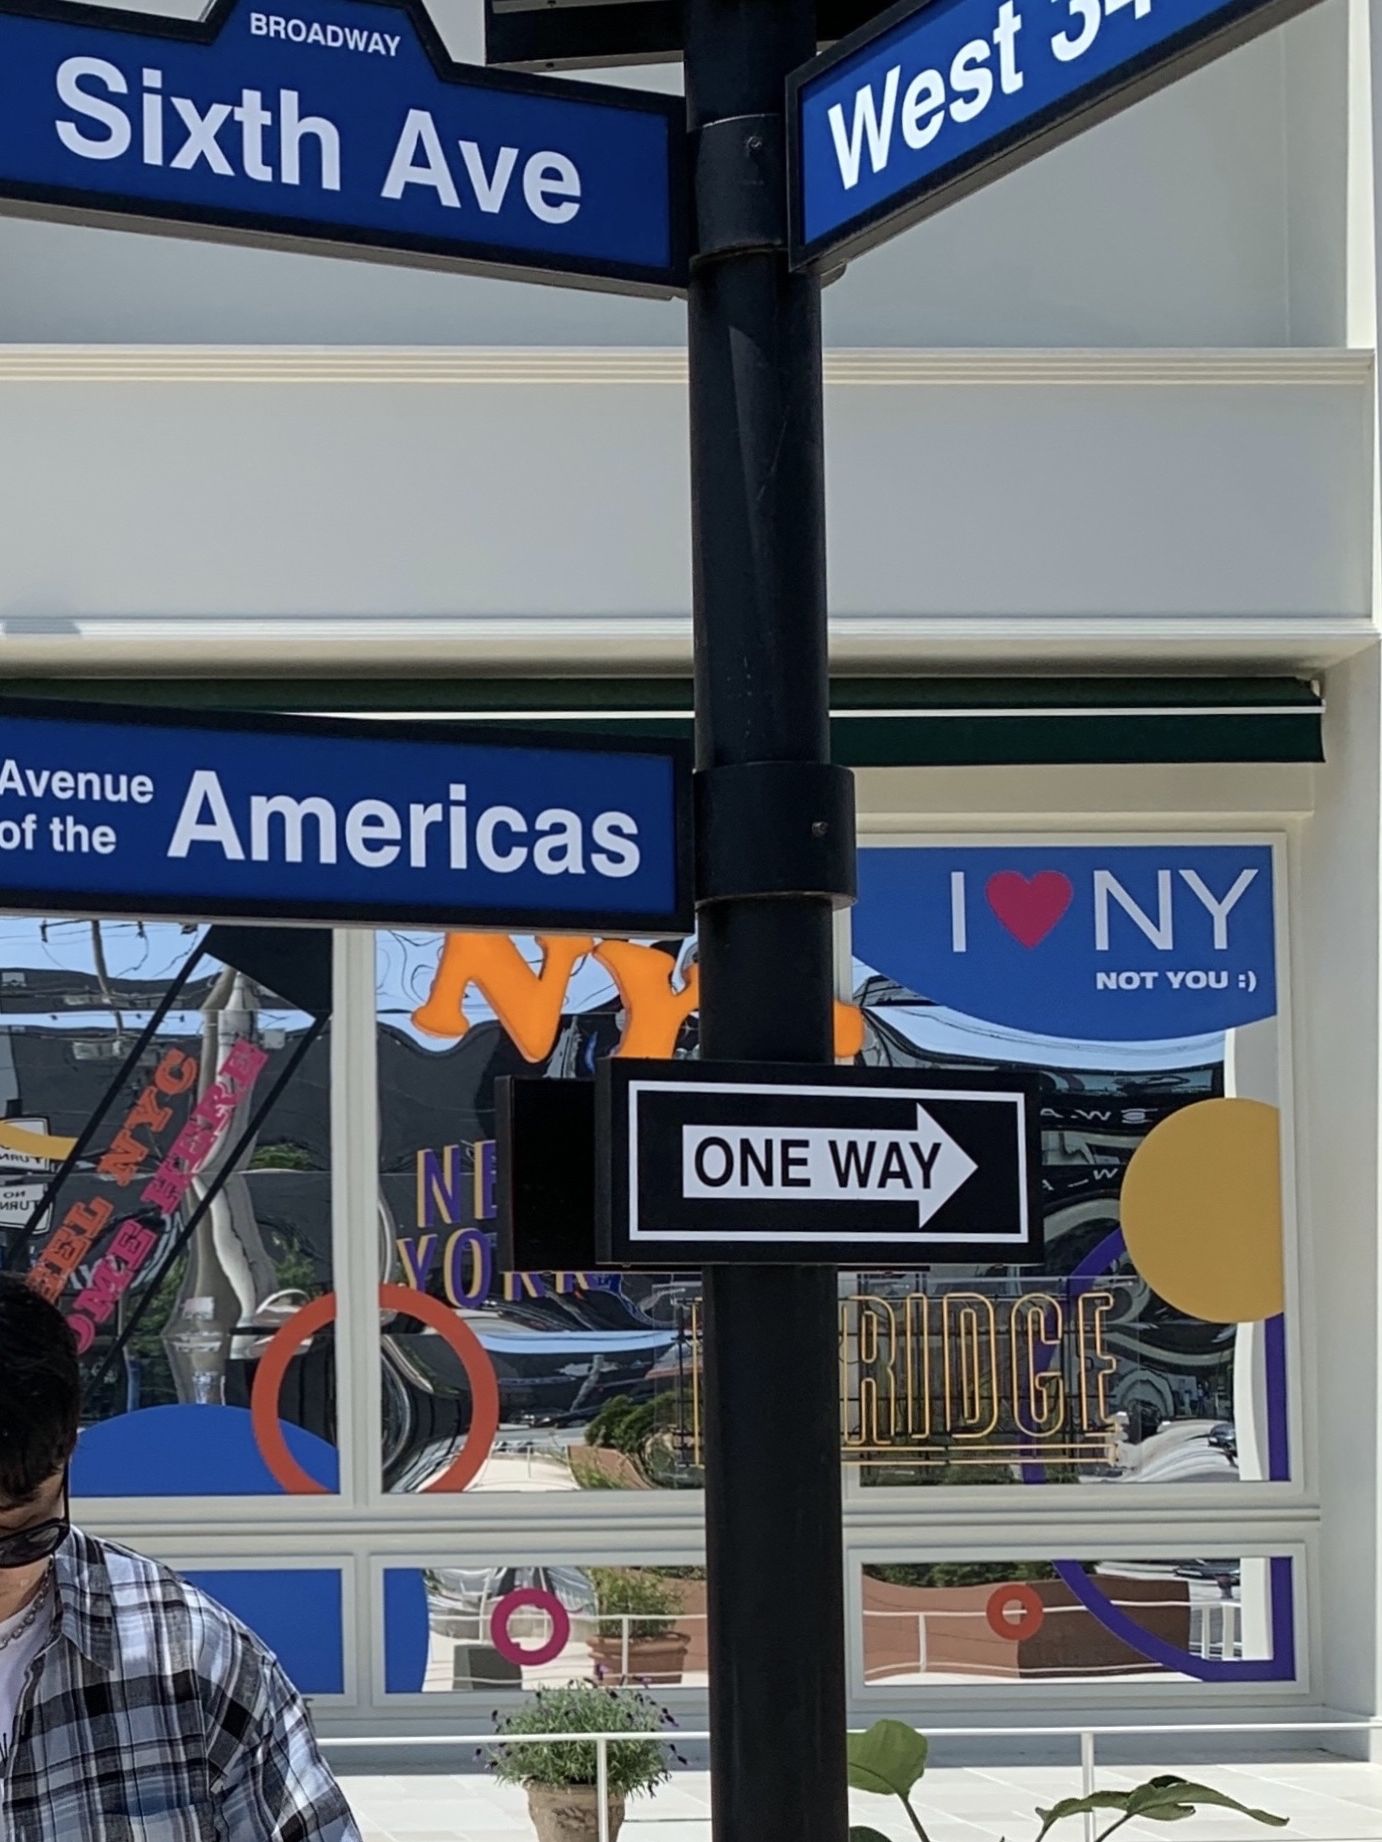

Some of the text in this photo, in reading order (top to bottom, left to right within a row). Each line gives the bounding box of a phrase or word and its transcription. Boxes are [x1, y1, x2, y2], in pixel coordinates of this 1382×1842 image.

[249, 13, 401, 56] BROADWAY
[55, 56, 582, 224] Sixth Ave
[827, 0, 1024, 191] West
[49, 815, 117, 855] the
[167, 769, 641, 879] Americas
[950, 869, 1259, 953] I NY
[1096, 971, 1159, 990] NOT
[1166, 970, 1229, 989] YOU
[96, 1047, 198, 1187] NYC
[693, 1136, 942, 1190] ONE WAY
[66, 1039, 268, 1355] OME HERE
